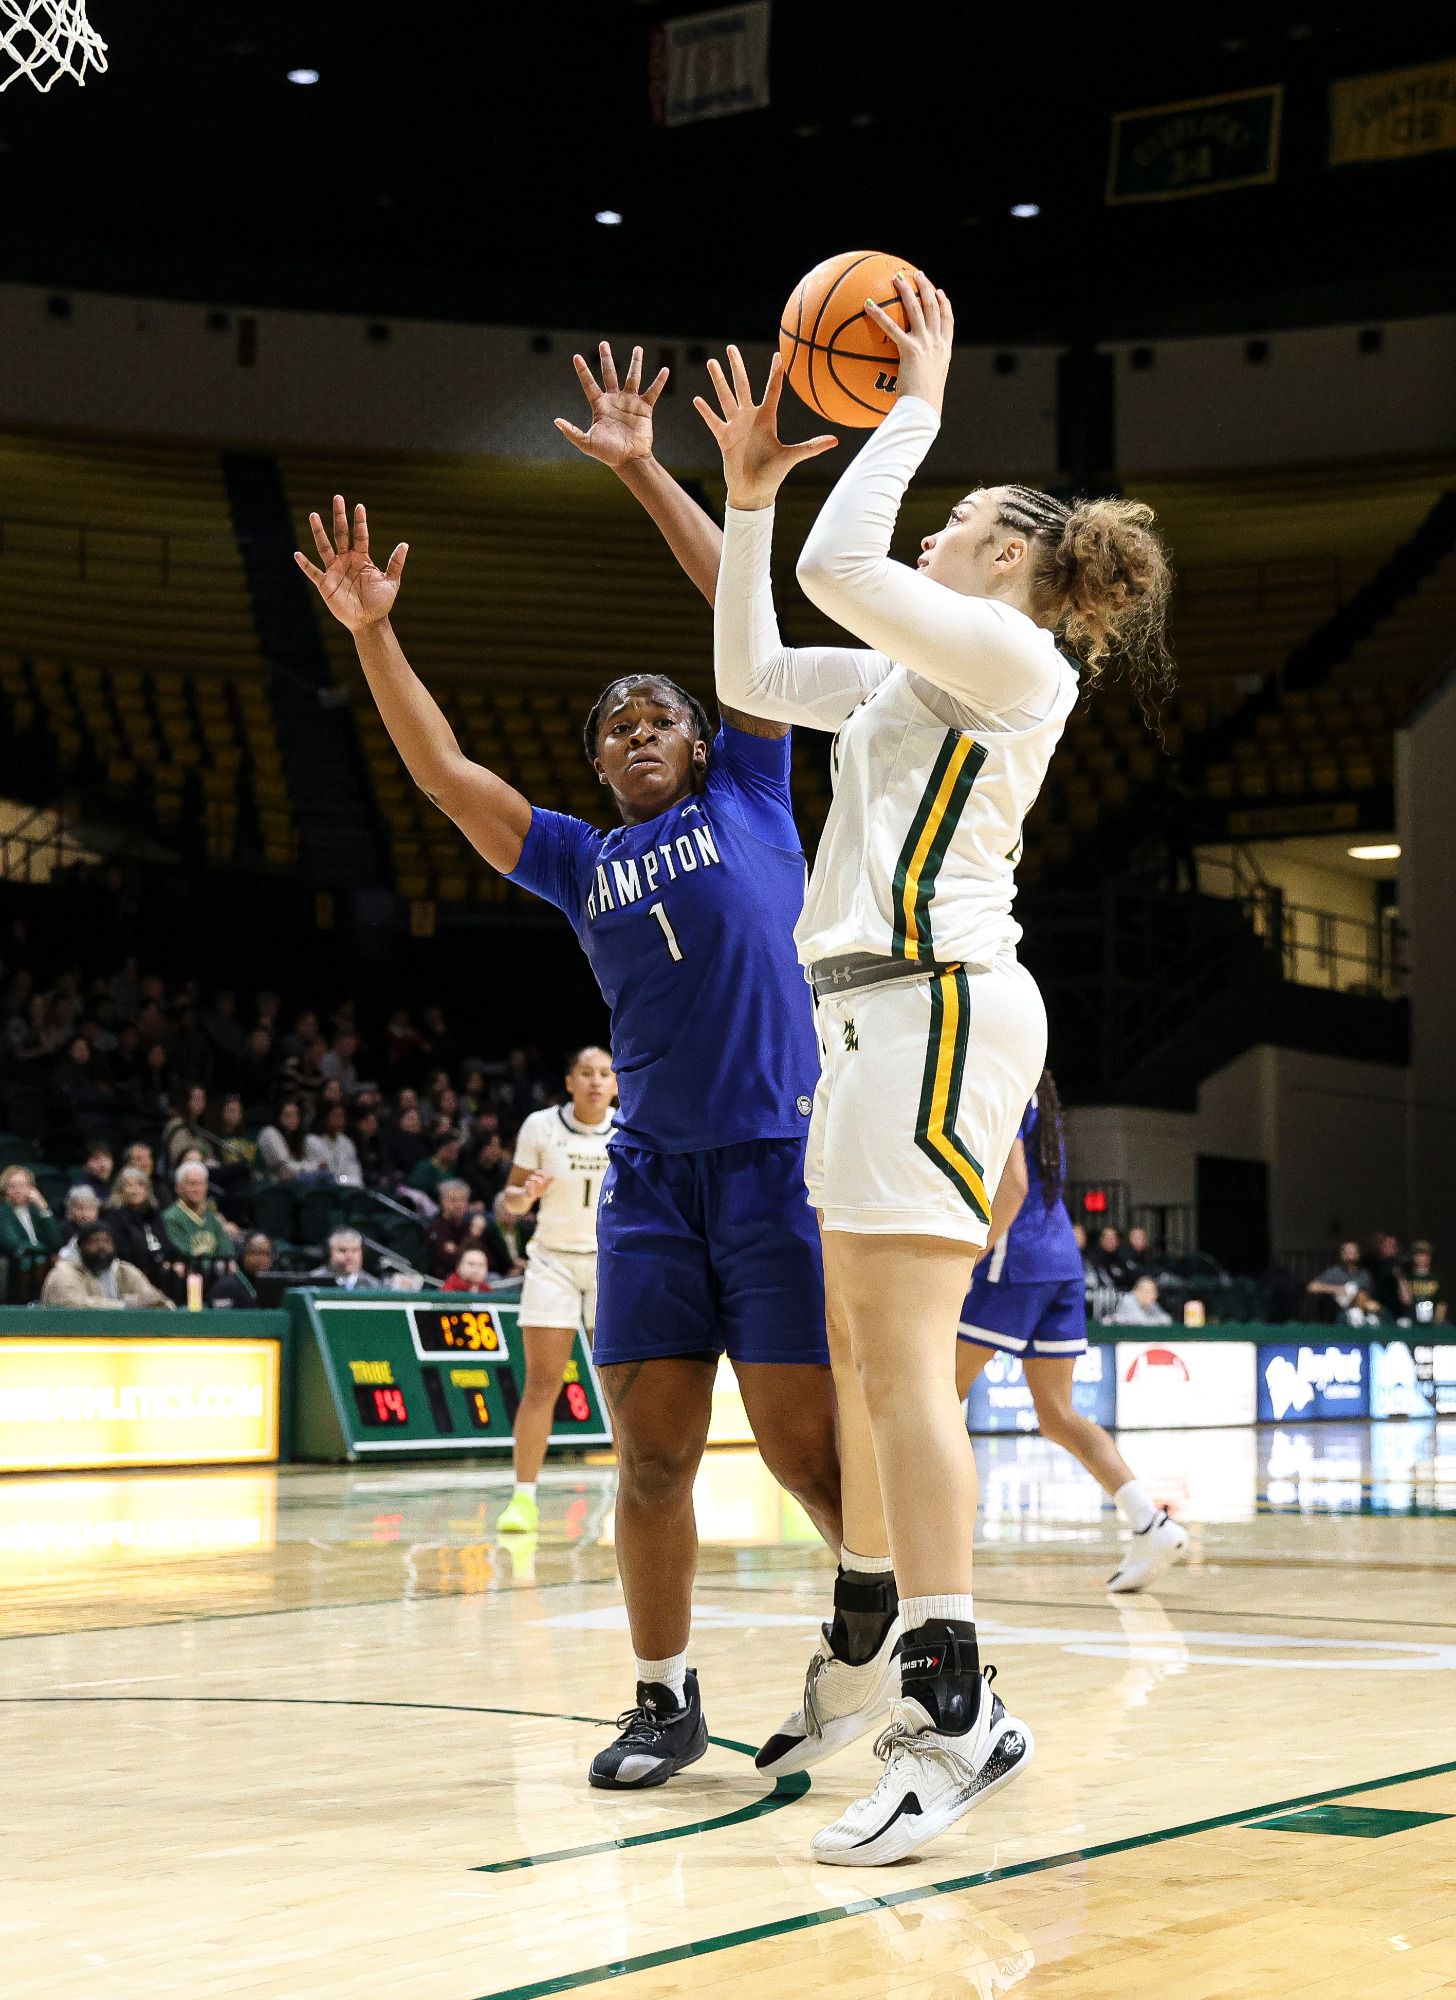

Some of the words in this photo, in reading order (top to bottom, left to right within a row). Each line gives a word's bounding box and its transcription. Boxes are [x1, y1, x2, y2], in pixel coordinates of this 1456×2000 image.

[648, 901, 683, 962] 1
[583, 1179, 591, 1208] 1
[440, 1312, 498, 1350] 1:36
[373, 1389, 408, 1422] 14
[474, 1392, 489, 1424] 1
[565, 1382, 590, 1421] 8
